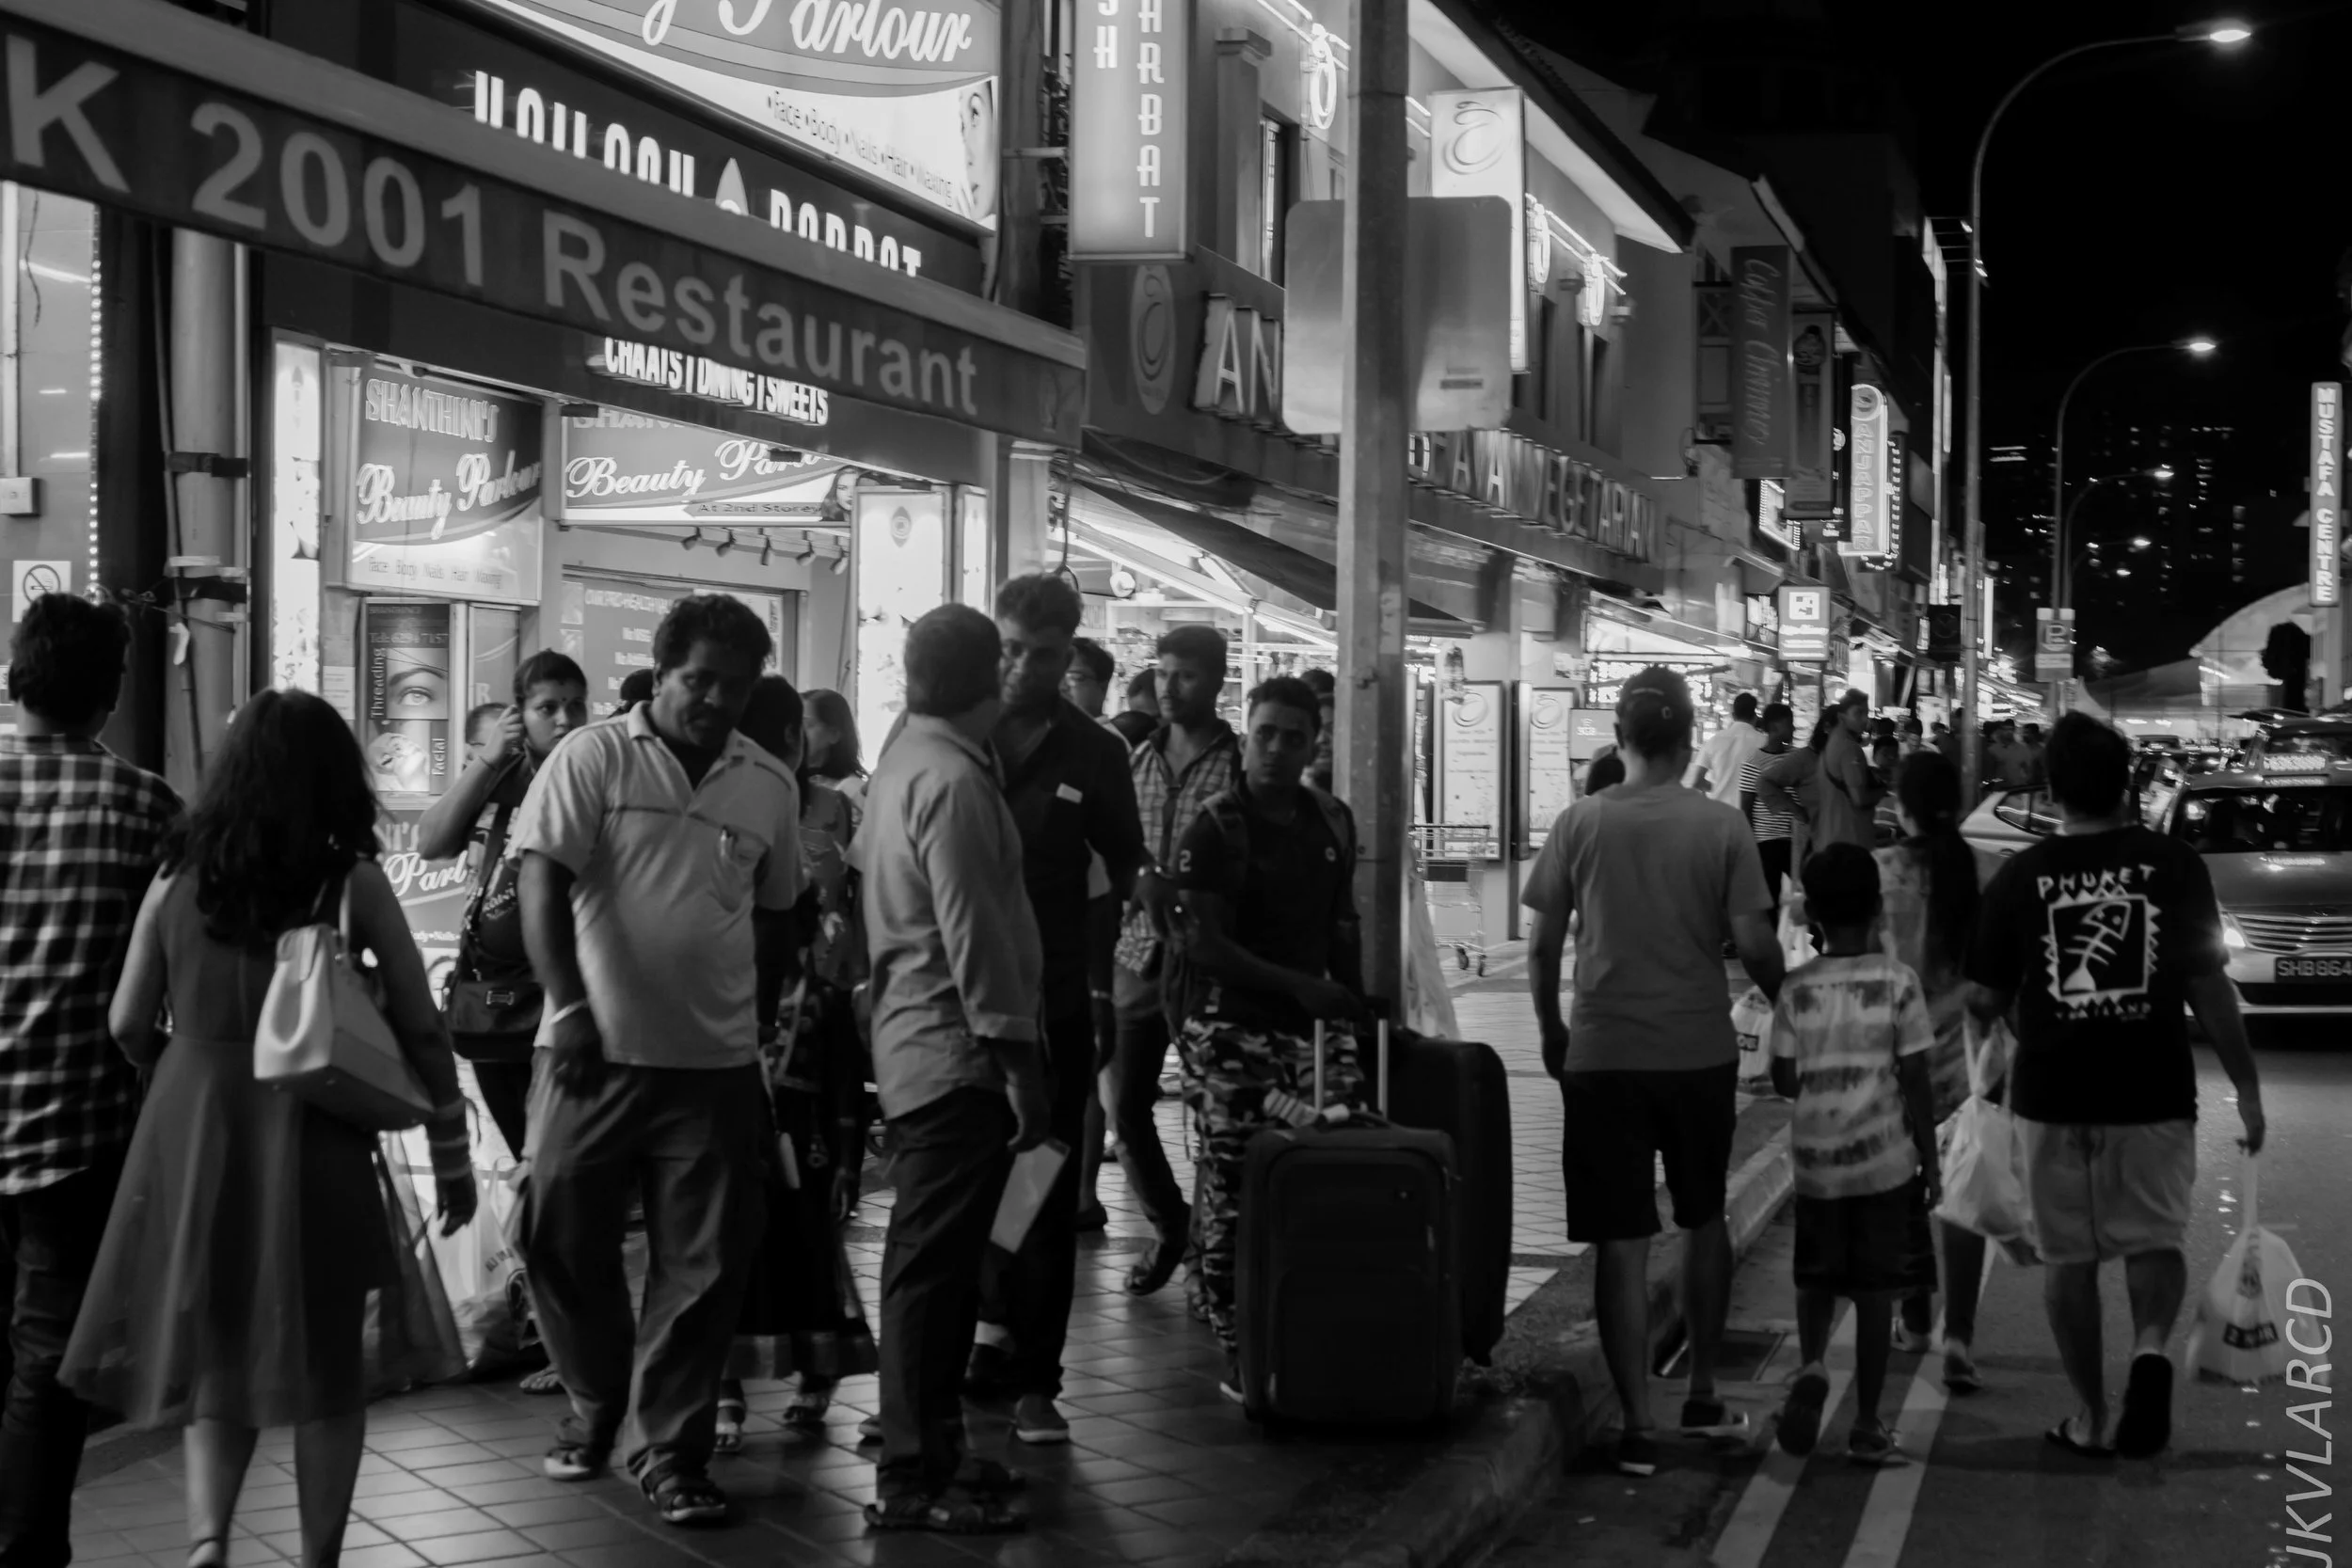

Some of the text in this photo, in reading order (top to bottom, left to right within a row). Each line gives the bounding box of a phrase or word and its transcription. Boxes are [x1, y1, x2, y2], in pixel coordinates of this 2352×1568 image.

[718, 0, 972, 62] arlour
[6, 33, 131, 194] K
[190, 102, 483, 288] 2001
[542, 208, 978, 417] Restaurant
[765, 376, 829, 425] SWEETS
[356, 462, 453, 541] Beauty
[564, 455, 706, 503] Beauty
[698, 503, 822, 515] At 2nd Storey
[1854, 422, 1875, 551] ANJAPPAR
[2316, 387, 2336, 602] MUSTAFA CENTRE
[370, 647, 388, 718] Threading
[431, 737, 446, 777] Facial
[2037, 863, 2156, 900] PHUKET
